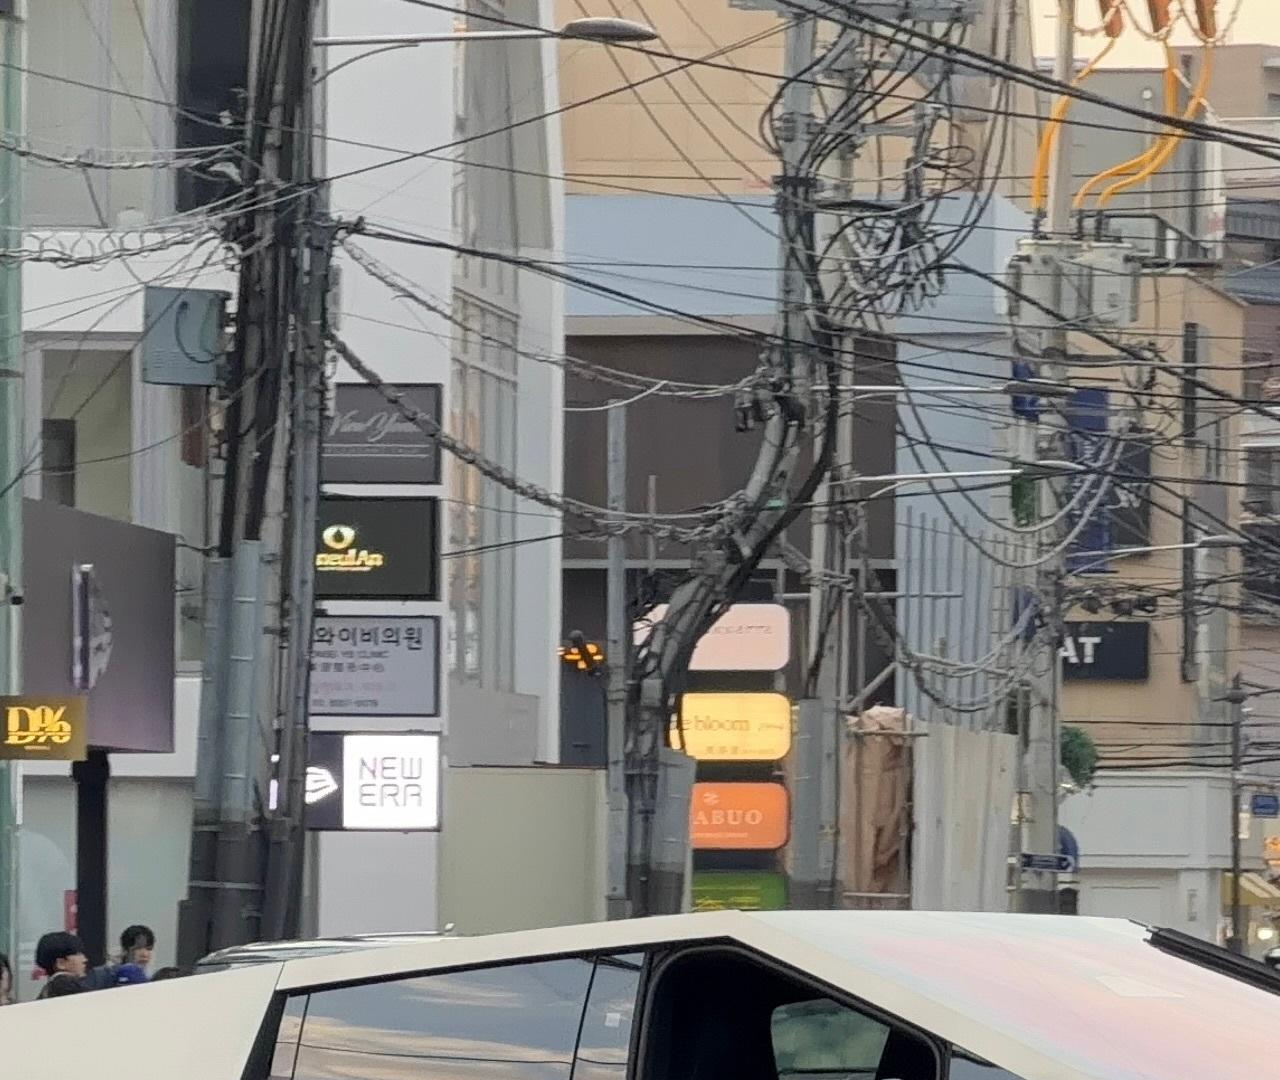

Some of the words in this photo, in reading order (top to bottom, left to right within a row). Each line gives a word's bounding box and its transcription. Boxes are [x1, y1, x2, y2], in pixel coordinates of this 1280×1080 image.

[313, 626, 423, 650] 와이비의원
[694, 715, 751, 732] bloom
[359, 756, 423, 780] NEW
[359, 783, 423, 807] ERA
